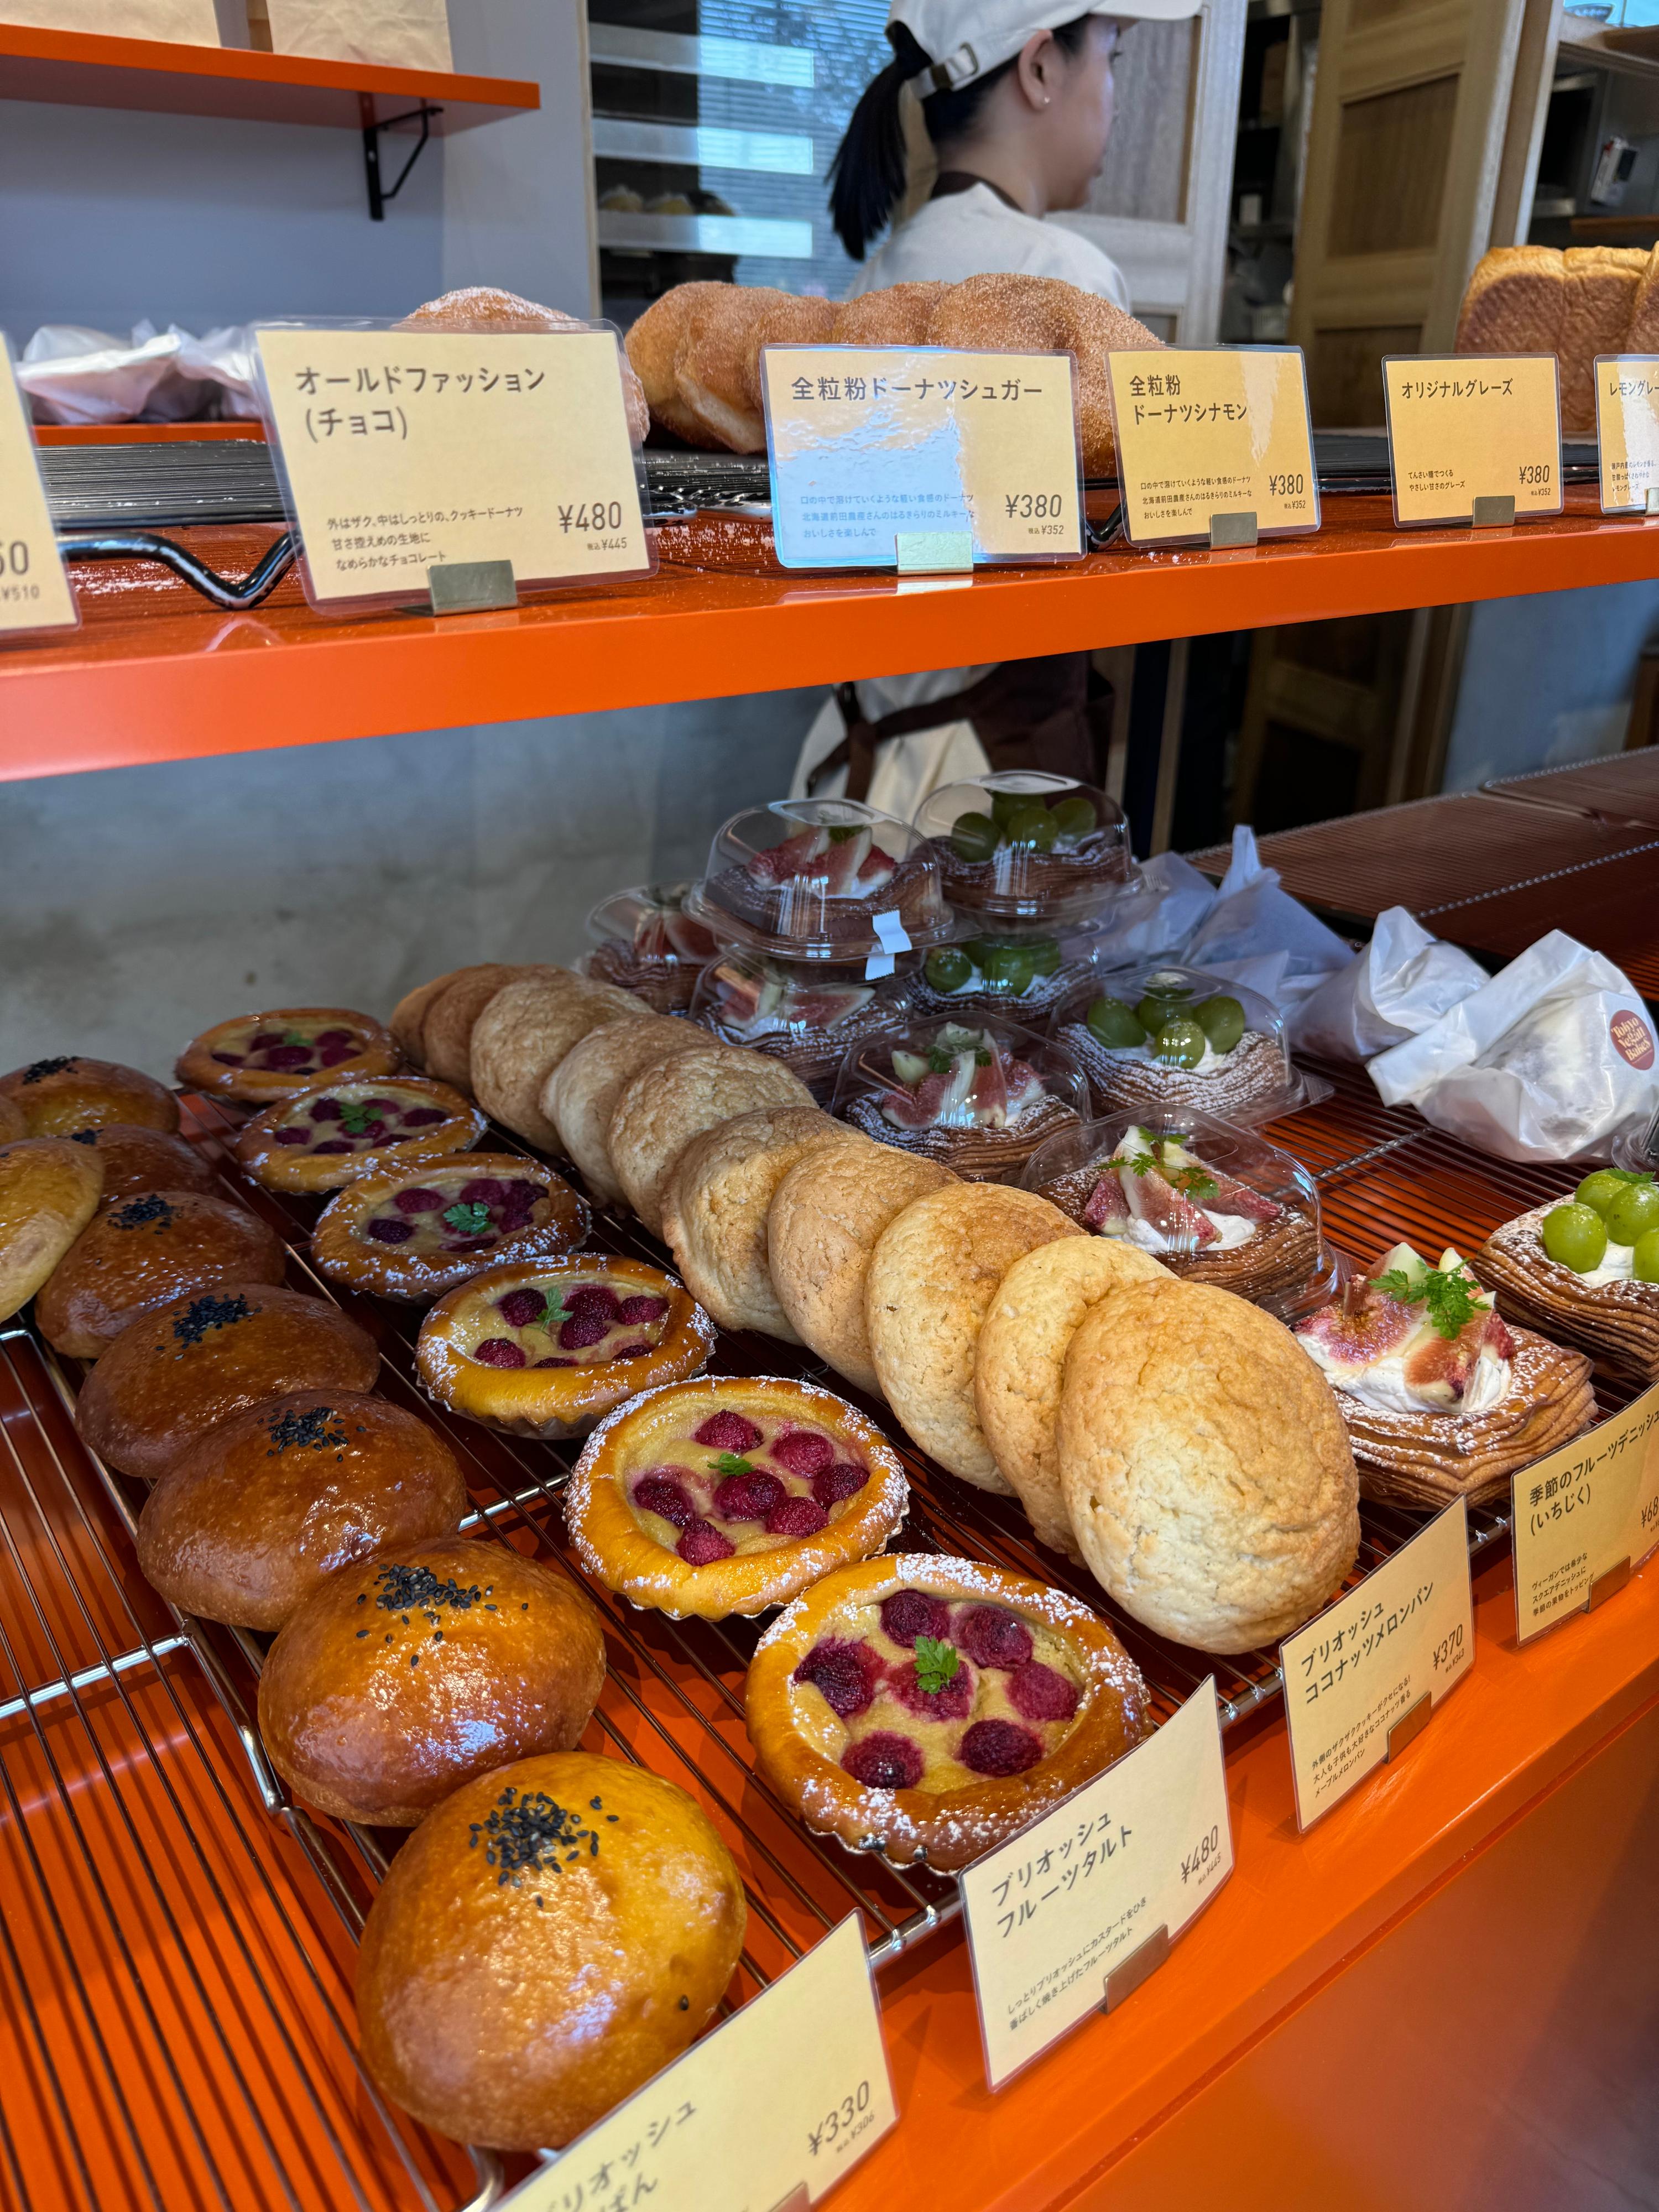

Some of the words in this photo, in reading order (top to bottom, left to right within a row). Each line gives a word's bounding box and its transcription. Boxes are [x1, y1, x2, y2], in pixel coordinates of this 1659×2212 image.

[295, 366, 545, 394] オールドファッション
[791, 376, 1042, 401] 全粒粉ドーナツシュガー
[1129, 374, 1181, 397] 全粒粉
[1402, 378, 1514, 399] オリジナルグレーズ
[306, 405, 408, 443] (チョコ)
[1134, 402, 1248, 425] ドーナツシナモン
[1269, 474, 1303, 496] ¥380
[1410, 481, 1465, 492] やさしい甘さのグレーズ
[1519, 465, 1550, 484] ¥380
[558, 501, 622, 534] ¥480
[1005, 494, 1062, 518] ¥380
[1144, 508, 1193, 519] おいしさを楽しんで
[332, 533, 431, 551] 甘さ控えめの生地に
[804, 528, 877, 539] おいしさを楽しんで
[336, 551, 446, 571] なめらかなチョコレート
[1610, 1018, 1639, 1039] Tokyo
[1618, 1026, 1646, 1048] Vegan
[1625, 1037, 1651, 1061] Bakes
[1530, 1483, 1591, 1536] (いちじく)
[1641, 1496, 1659, 1528] ¥68
[1532, 1566, 1586, 1604] スクエアデニッシュに
[1301, 1602, 1384, 1677] ブリオッシュ
[1306, 1582, 1433, 1705] ココナッツメロンパン
[1433, 1624, 1463, 1671] ¥370
[992, 1813, 1112, 1907] ブリオッシュ
[1181, 1824, 1218, 1885] ¥480
[997, 1825, 1133, 1938] フルーツタルト
[808, 2080, 869, 2157] ¥330
[546, 2101, 696, 2212] リオッシュ
